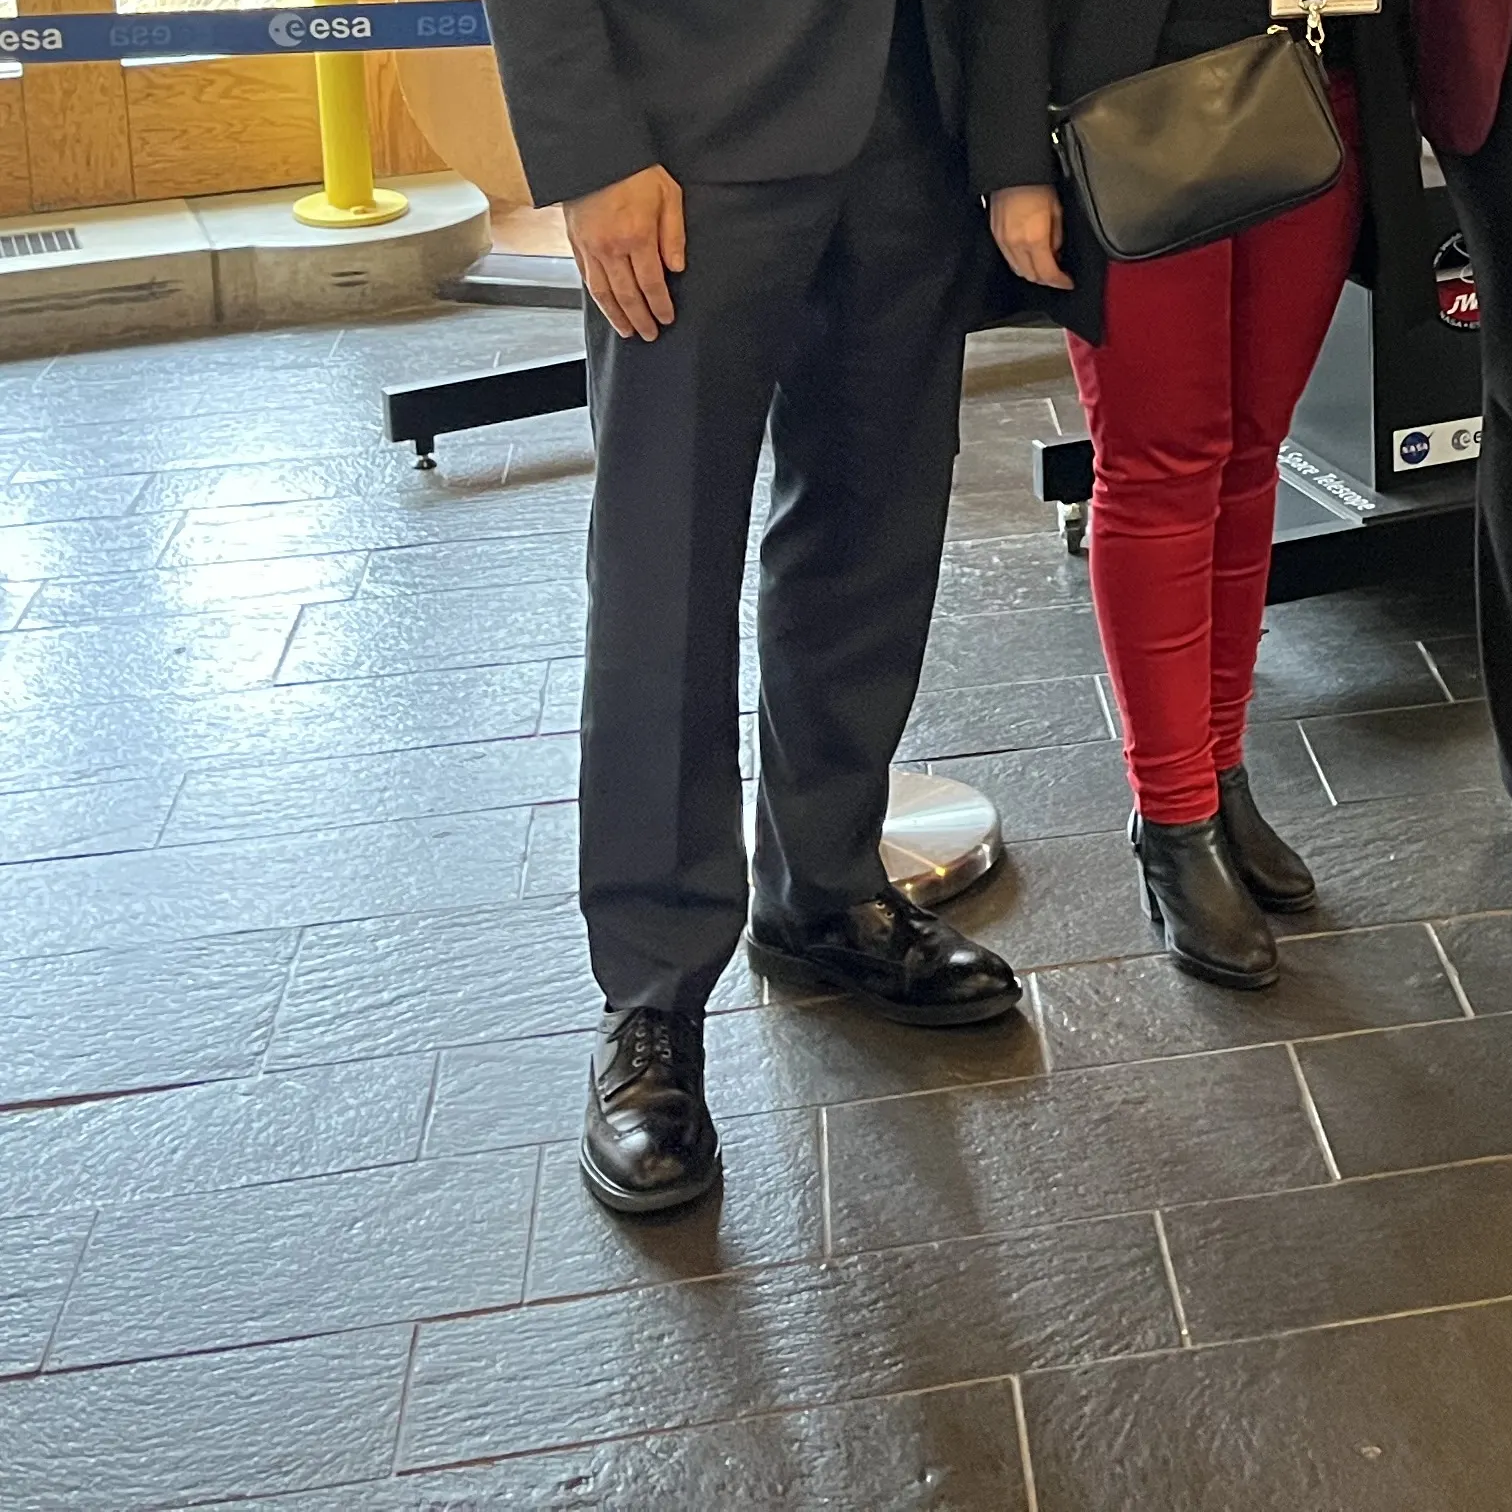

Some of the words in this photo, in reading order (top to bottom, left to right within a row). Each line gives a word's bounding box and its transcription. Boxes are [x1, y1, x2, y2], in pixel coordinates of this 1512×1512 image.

[309, 16, 372, 39] esa
[0, 28, 62, 51] esa
[1446, 292, 1479, 315] JW
[1402, 442, 1429, 454] NASA
[1312, 473, 1376, 511] Telescope
